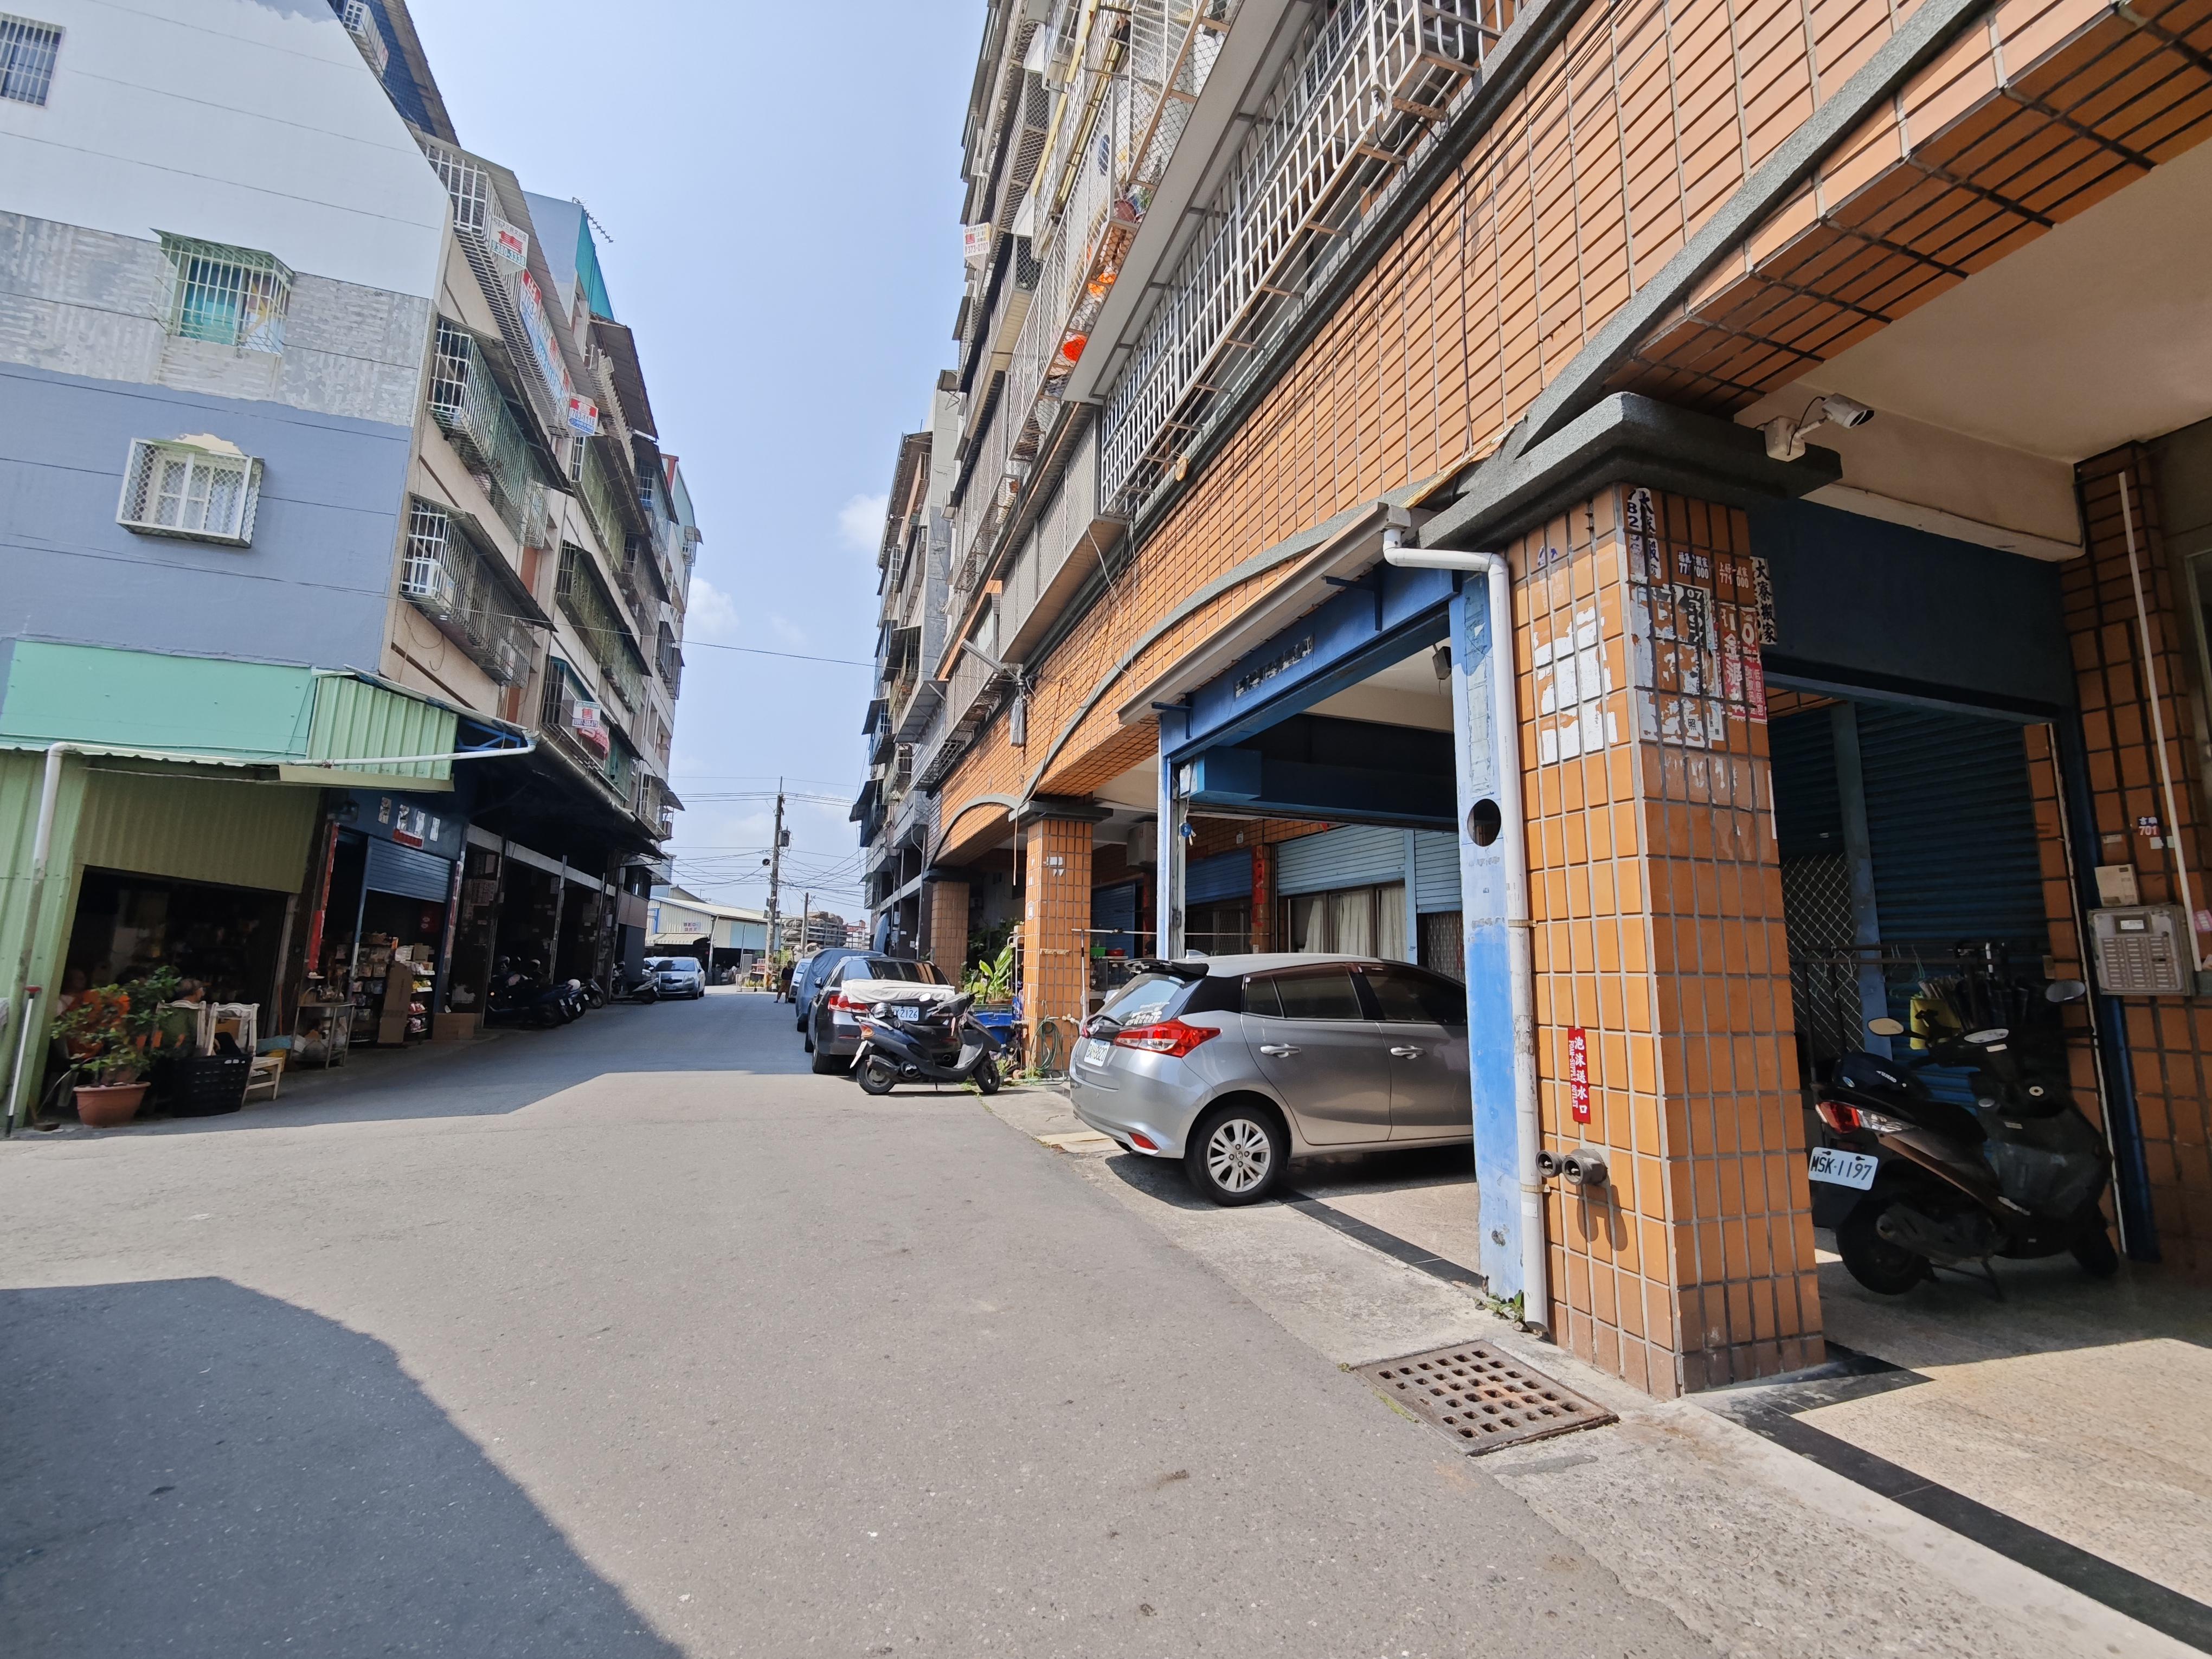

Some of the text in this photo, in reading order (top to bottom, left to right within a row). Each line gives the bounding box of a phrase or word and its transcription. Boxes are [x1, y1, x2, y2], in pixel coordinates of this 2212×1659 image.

[497, 230, 523, 254] 售
[1574, 1036, 1589, 1114] 泡沫送水口
